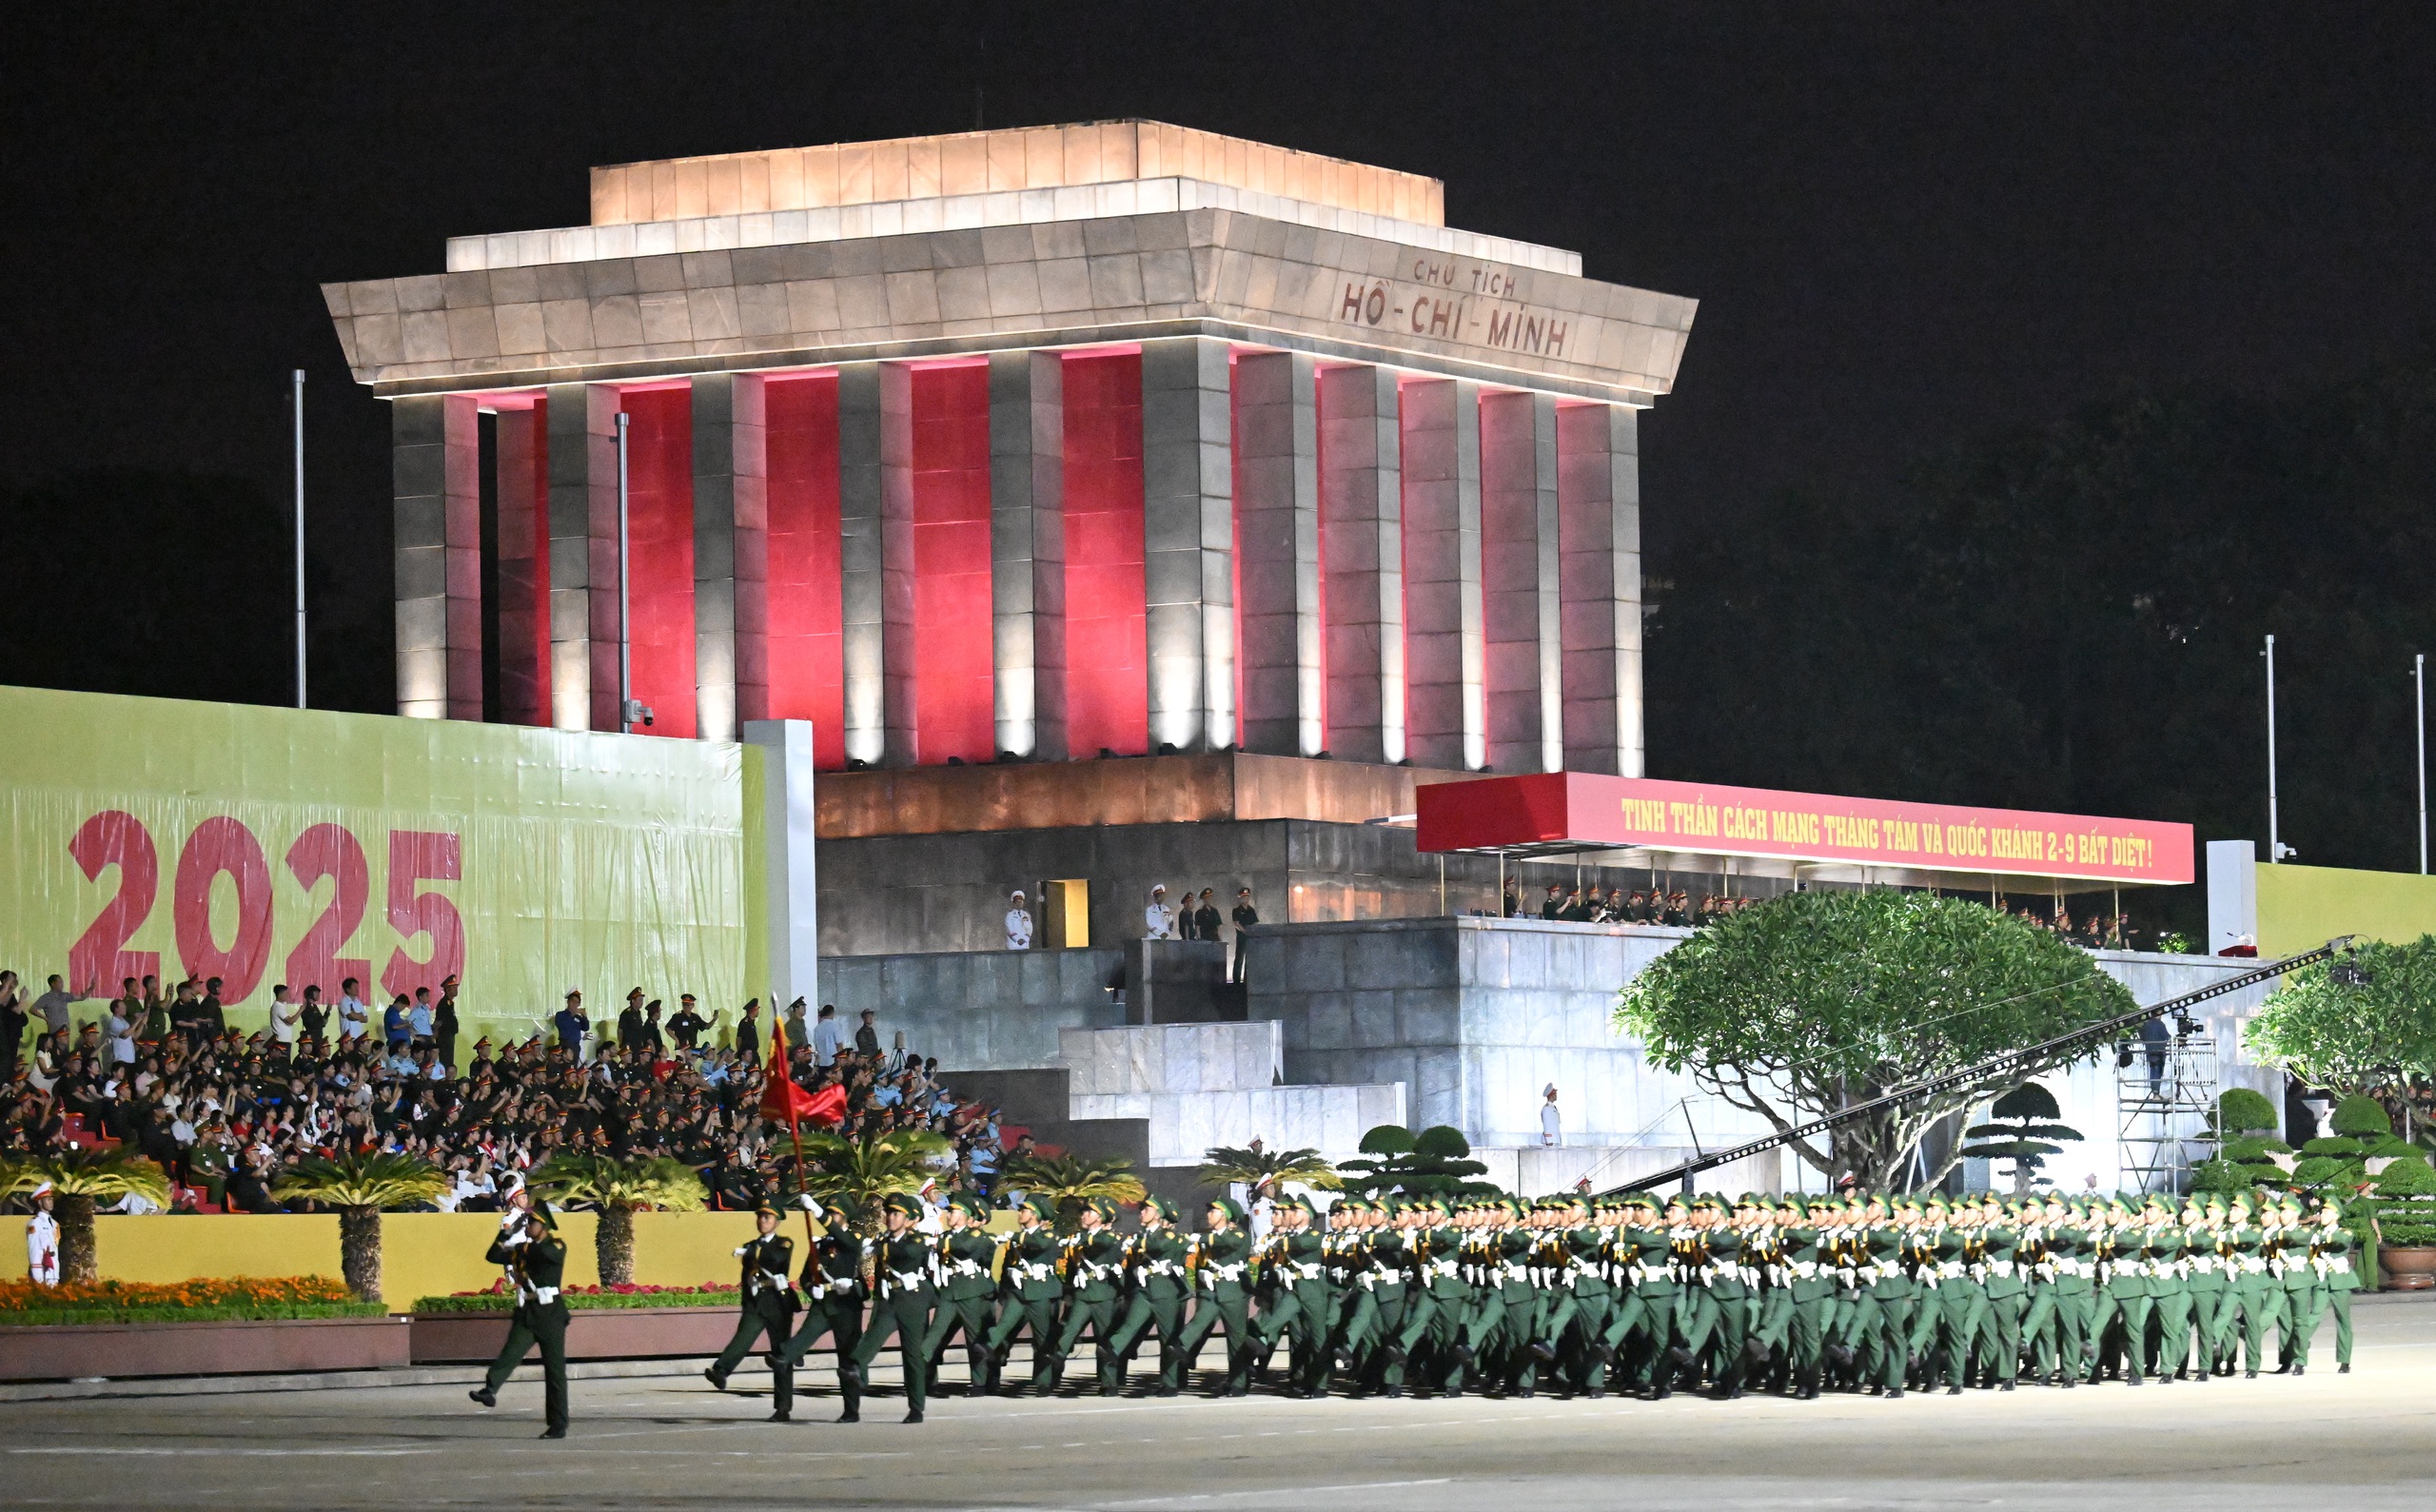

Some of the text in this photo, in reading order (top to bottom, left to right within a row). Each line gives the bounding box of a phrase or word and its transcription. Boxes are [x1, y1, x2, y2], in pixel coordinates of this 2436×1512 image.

[1341, 280, 1390, 325] HỒ
[1411, 295, 1468, 339] CHÍ
[1487, 303, 1567, 357] MINH
[1621, 793, 2152, 873] TINH THẦN CÁCH MẠNG THÁNG TÁM VÀ QUỐC KHÁNH 2-9 BẤT DIỆT!
[68, 810, 465, 1010] 2025
